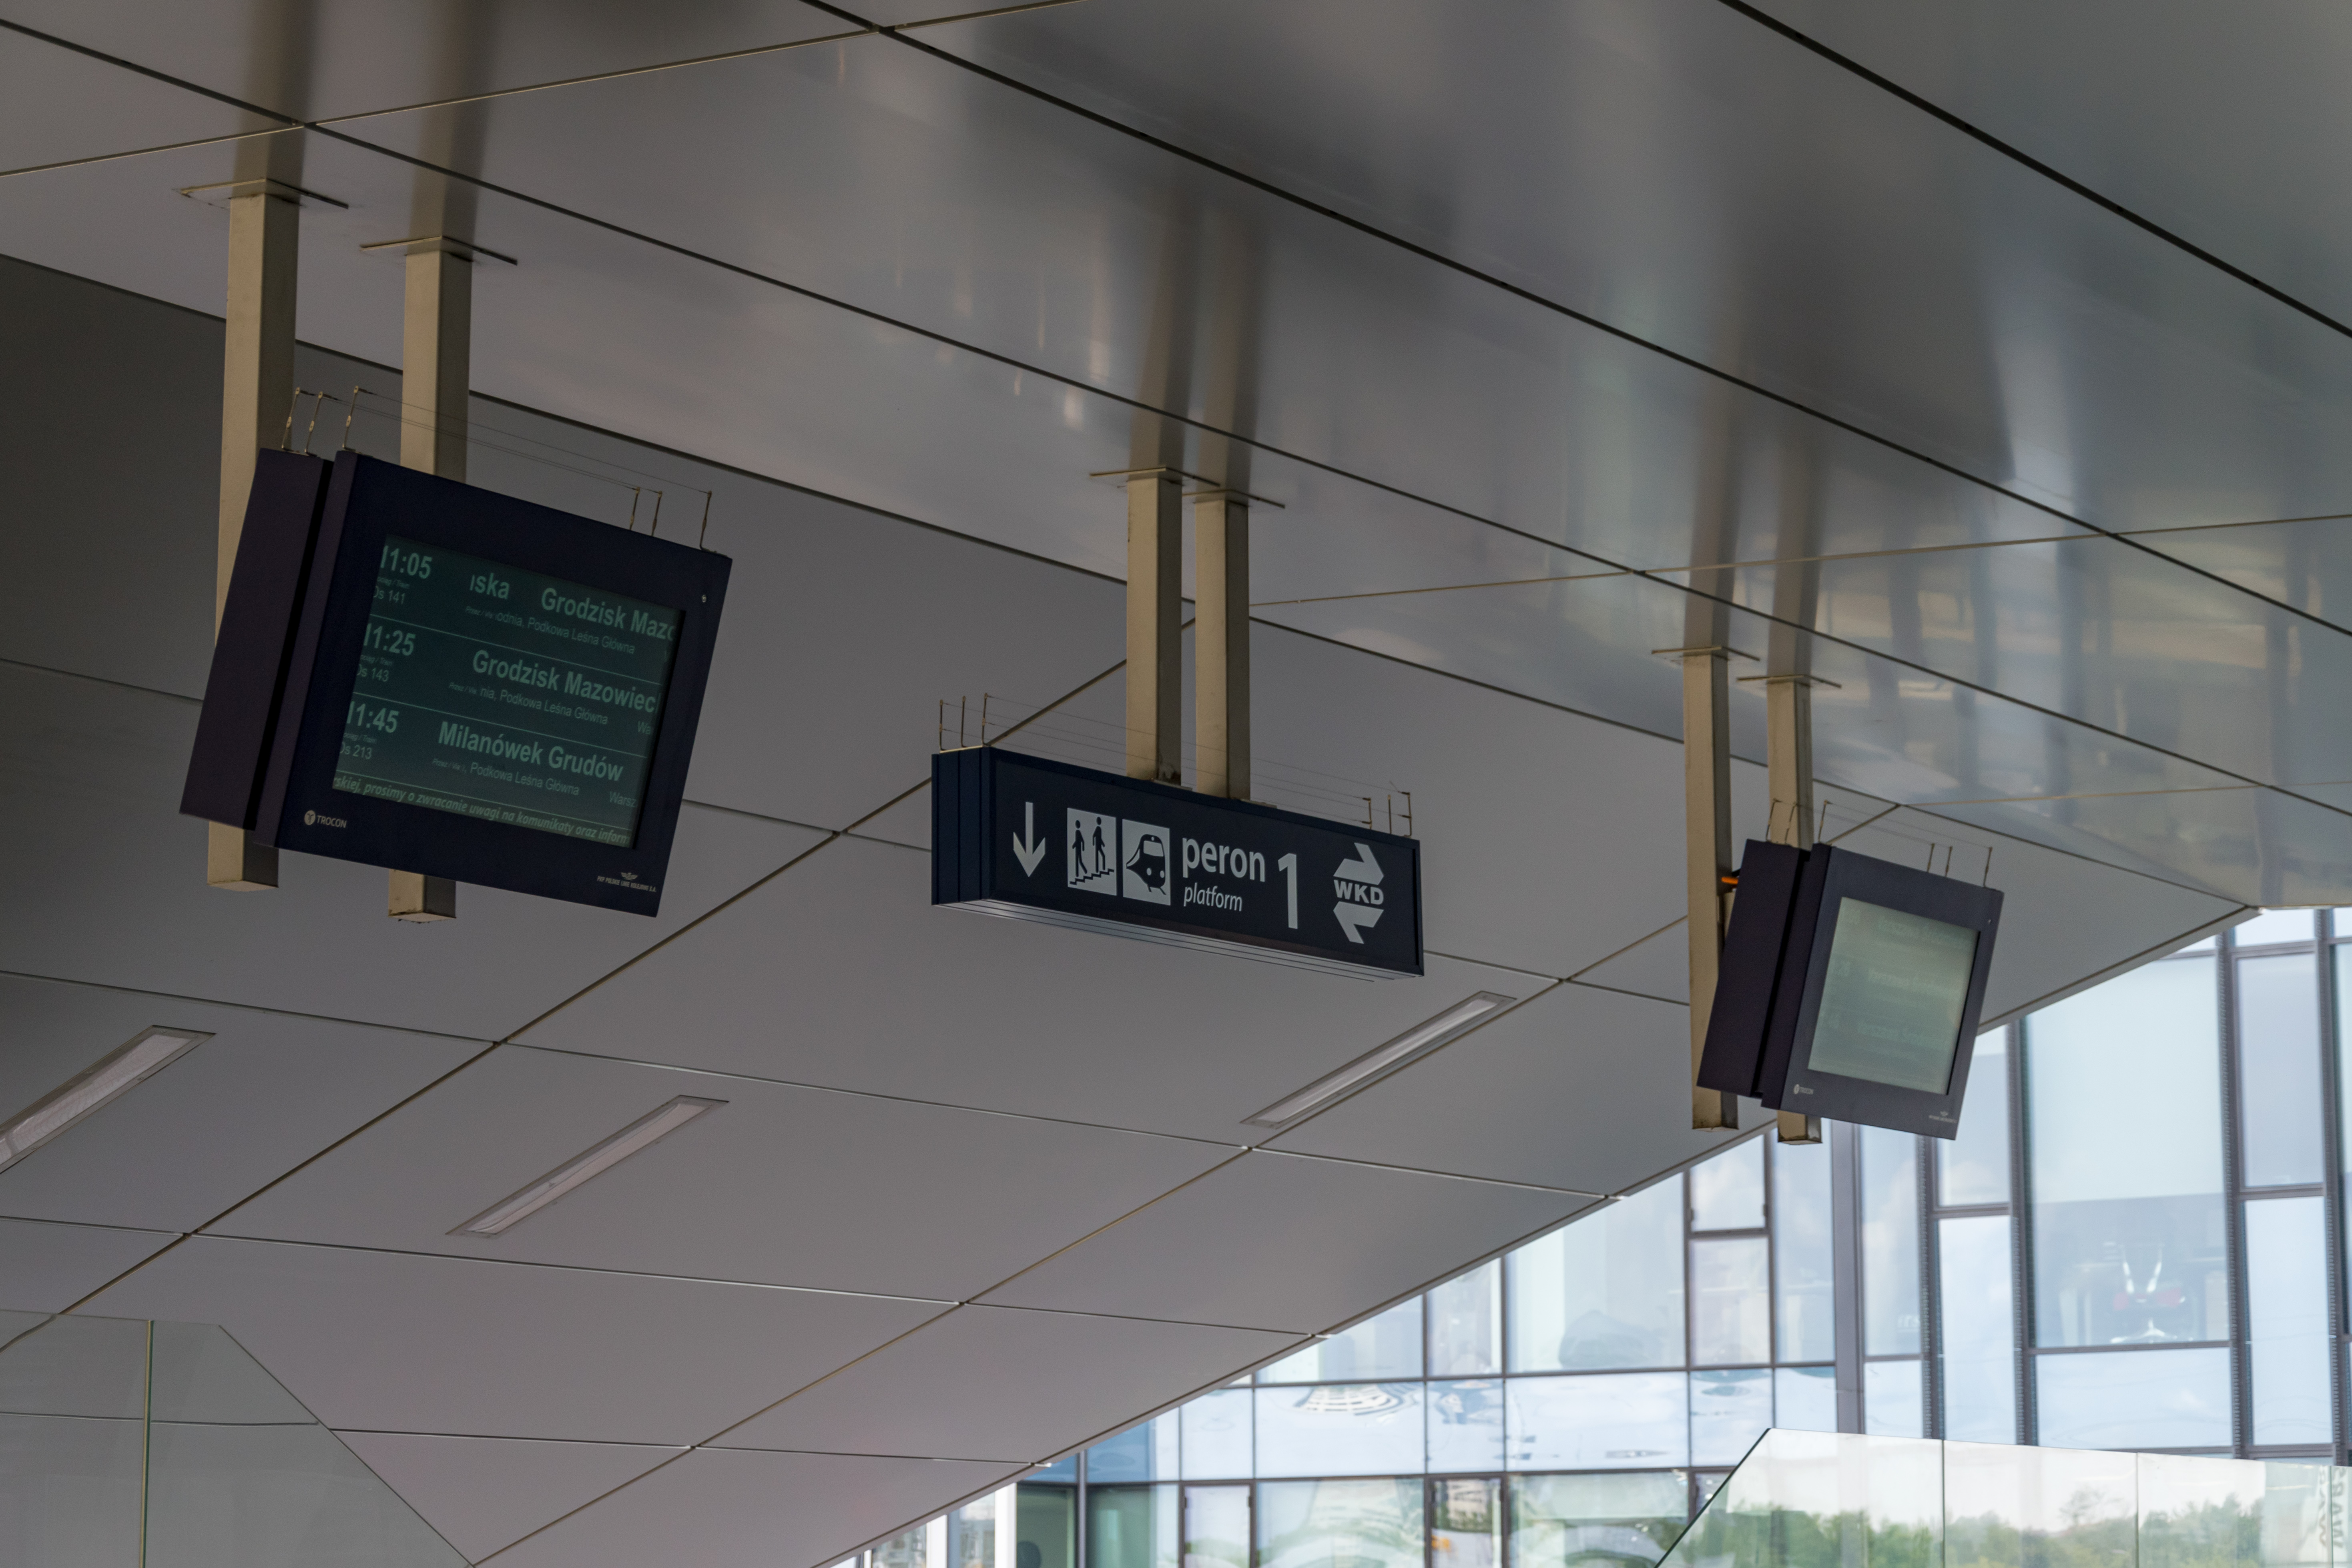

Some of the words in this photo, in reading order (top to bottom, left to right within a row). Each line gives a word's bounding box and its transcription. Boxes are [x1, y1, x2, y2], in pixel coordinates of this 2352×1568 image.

[380, 545, 433, 579] 11:05
[388, 590, 406, 605] 141
[541, 587, 627, 629] Grodzisk
[363, 622, 416, 656] 11:25
[495, 611, 524, 628] odnia,
[527, 616, 569, 638] Podkowa
[572, 628, 599, 646] Leśna
[601, 635, 636, 655] Główna
[371, 667, 389, 682] 143
[472, 649, 560, 691] Grodzisk
[564, 671, 660, 714] Mazowiec
[346, 700, 399, 733] 11:45
[500, 689, 542, 711] Podkowa
[544, 699, 572, 717] Leśna
[574, 706, 608, 725] Główna
[352, 744, 373, 759] 213
[438, 720, 544, 765] Milanówek
[548, 745, 624, 782] Grudów
[470, 761, 513, 783] Podkowa
[514, 771, 543, 788] Leśna
[545, 777, 580, 796] Główna
[317, 815, 347, 828] TROCON
[362, 783, 407, 802] prosimy
[407, 792, 415, 801] o
[416, 794, 468, 812] zwracanie
[469, 803, 502, 821] uwagi
[502, 811, 514, 821] na
[516, 811, 575, 836] komunikaty
[575, 823, 597, 838] oraz
[1182, 838, 1265, 882] peron
[1184, 882, 1242, 911] platform
[1278, 853, 1298, 929] 1
[1333, 879, 1384, 905] WKD
